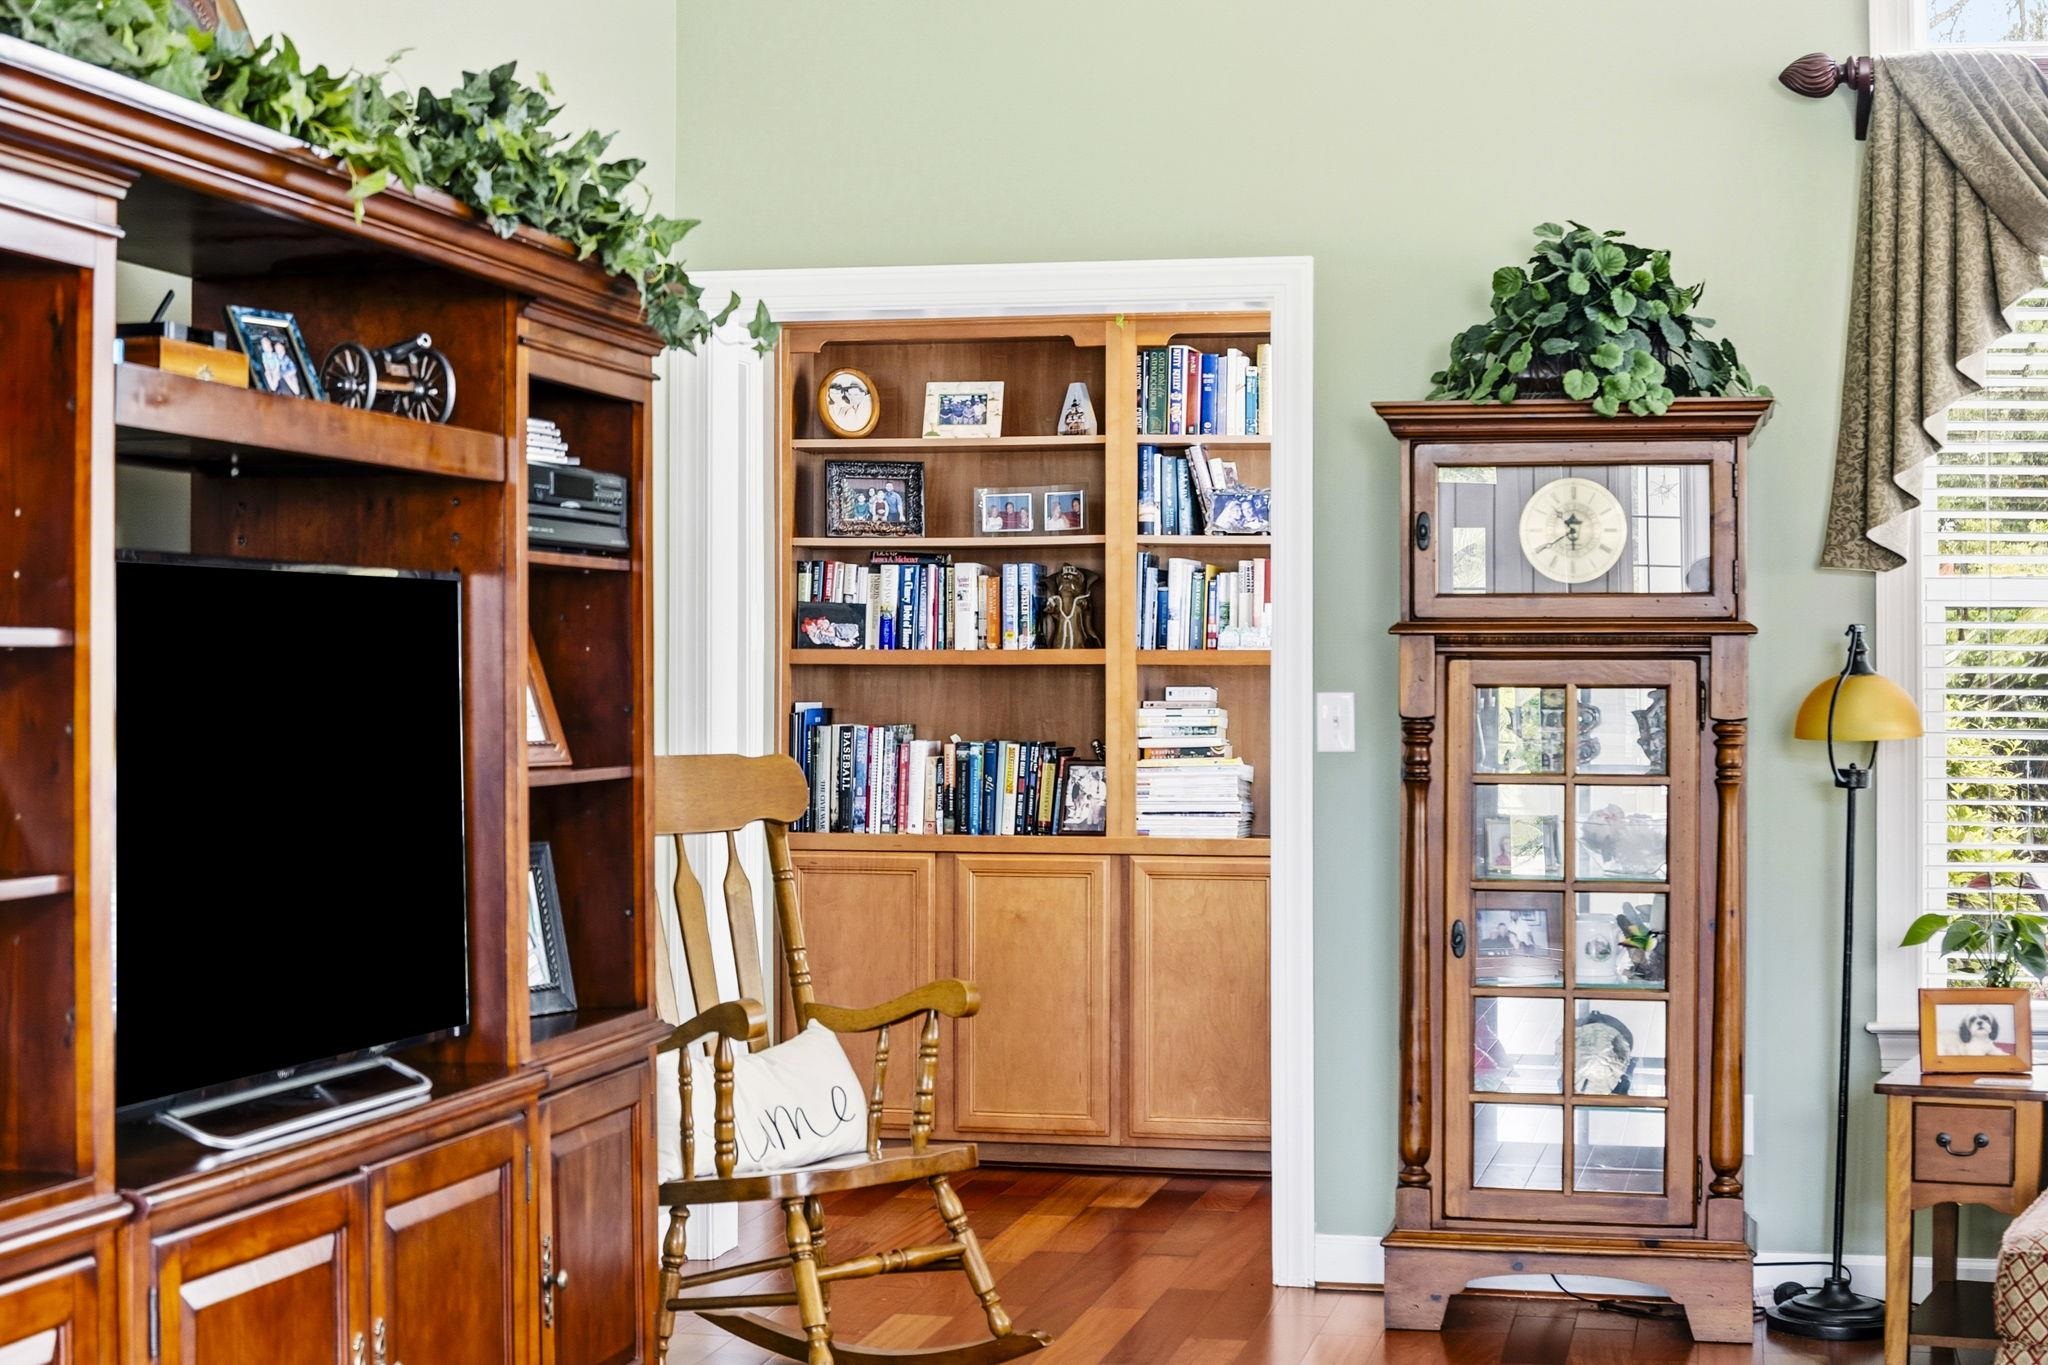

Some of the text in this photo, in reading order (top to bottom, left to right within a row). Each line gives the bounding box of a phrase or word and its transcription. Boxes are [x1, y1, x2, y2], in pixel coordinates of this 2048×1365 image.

[901, 567, 914, 604] Tom Clancy
[842, 731, 852, 791] BASEBALL
[984, 774, 996, 793] 1776
